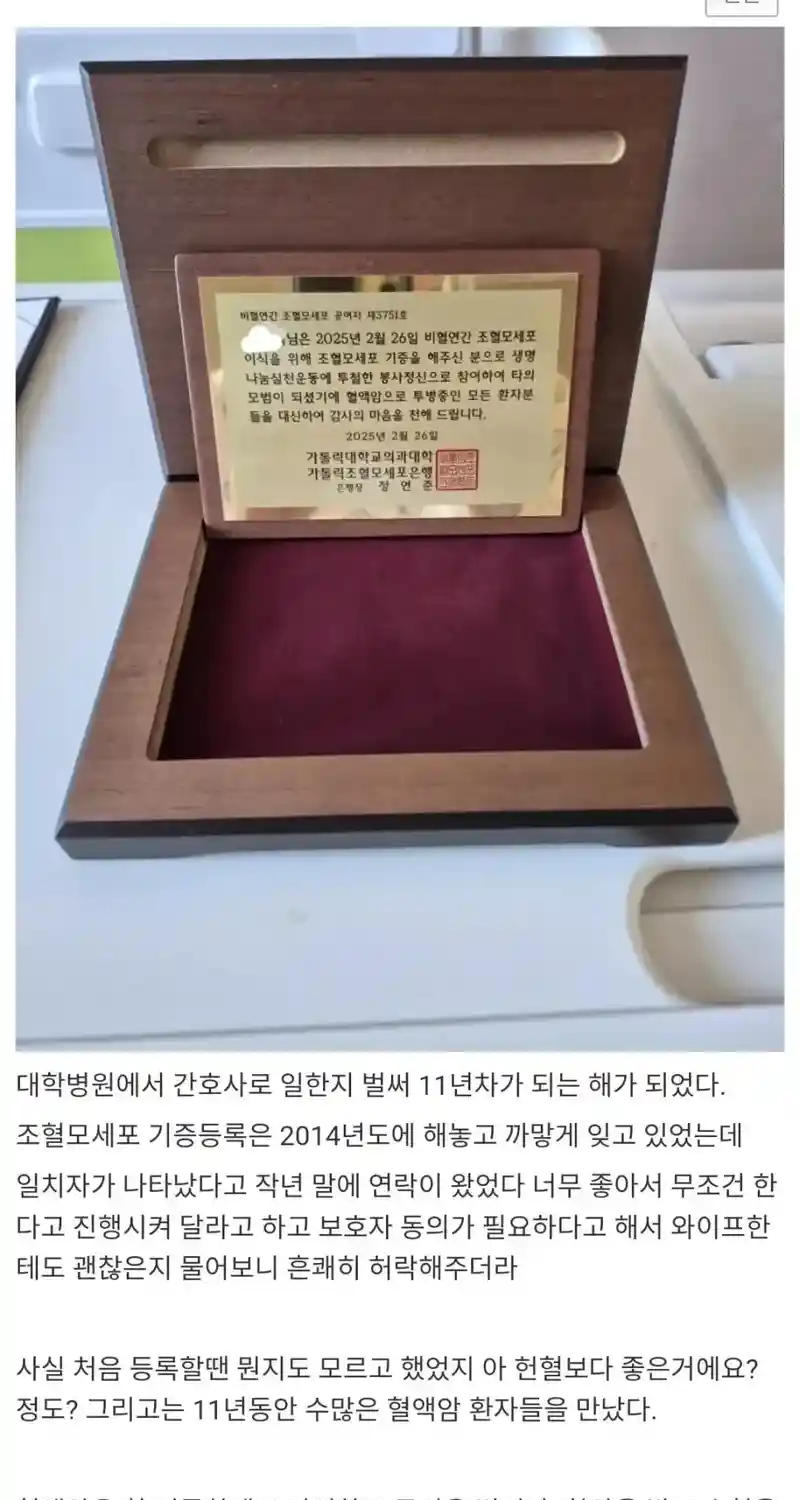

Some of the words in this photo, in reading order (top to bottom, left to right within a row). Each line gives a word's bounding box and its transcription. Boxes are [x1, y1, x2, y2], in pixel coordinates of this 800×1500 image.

[282, 332, 310, 346] 님은
[316, 332, 360, 345] 2025년
[366, 332, 385, 345] 2월
[391, 331, 418, 345] 26일
[424, 331, 472, 344] 비혈연간
[477, 330, 536, 344] 조혈모세포
[245, 352, 280, 365] 이식을
[288, 352, 311, 365] 위해
[318, 352, 378, 365] 조혈모세포
[386, 351, 420, 364] 기증을
[428, 351, 463, 364] 해주신
[469, 350, 505, 364] 분으로
[512, 349, 535, 363] 생명
[246, 372, 331, 385] 나눔실천운동에
[338, 371, 373, 384] 투철한
[380, 370, 451, 384] 봉사정신으로
[457, 370, 504, 383] 참여하여
[511, 369, 534, 383] 타의
[248, 391, 284, 404] 모범이
[346, 390, 407, 404] 혈액암으로
[414, 390, 461, 403] 투병중인
[468, 389, 491, 401] 모든
[498, 388, 533, 401] 환자분
[250, 410, 272, 423] 들을
[278, 410, 324, 422] 대신하여
[330, 409, 364, 423] 감사의
[369, 409, 404, 422] 마음을
[410, 408, 431, 421] 전해
[437, 407, 486, 421] 드립니다.
[345, 431, 385, 442] 2025년
[392, 431, 408, 441] 2월
[414, 430, 438, 441] 26일
